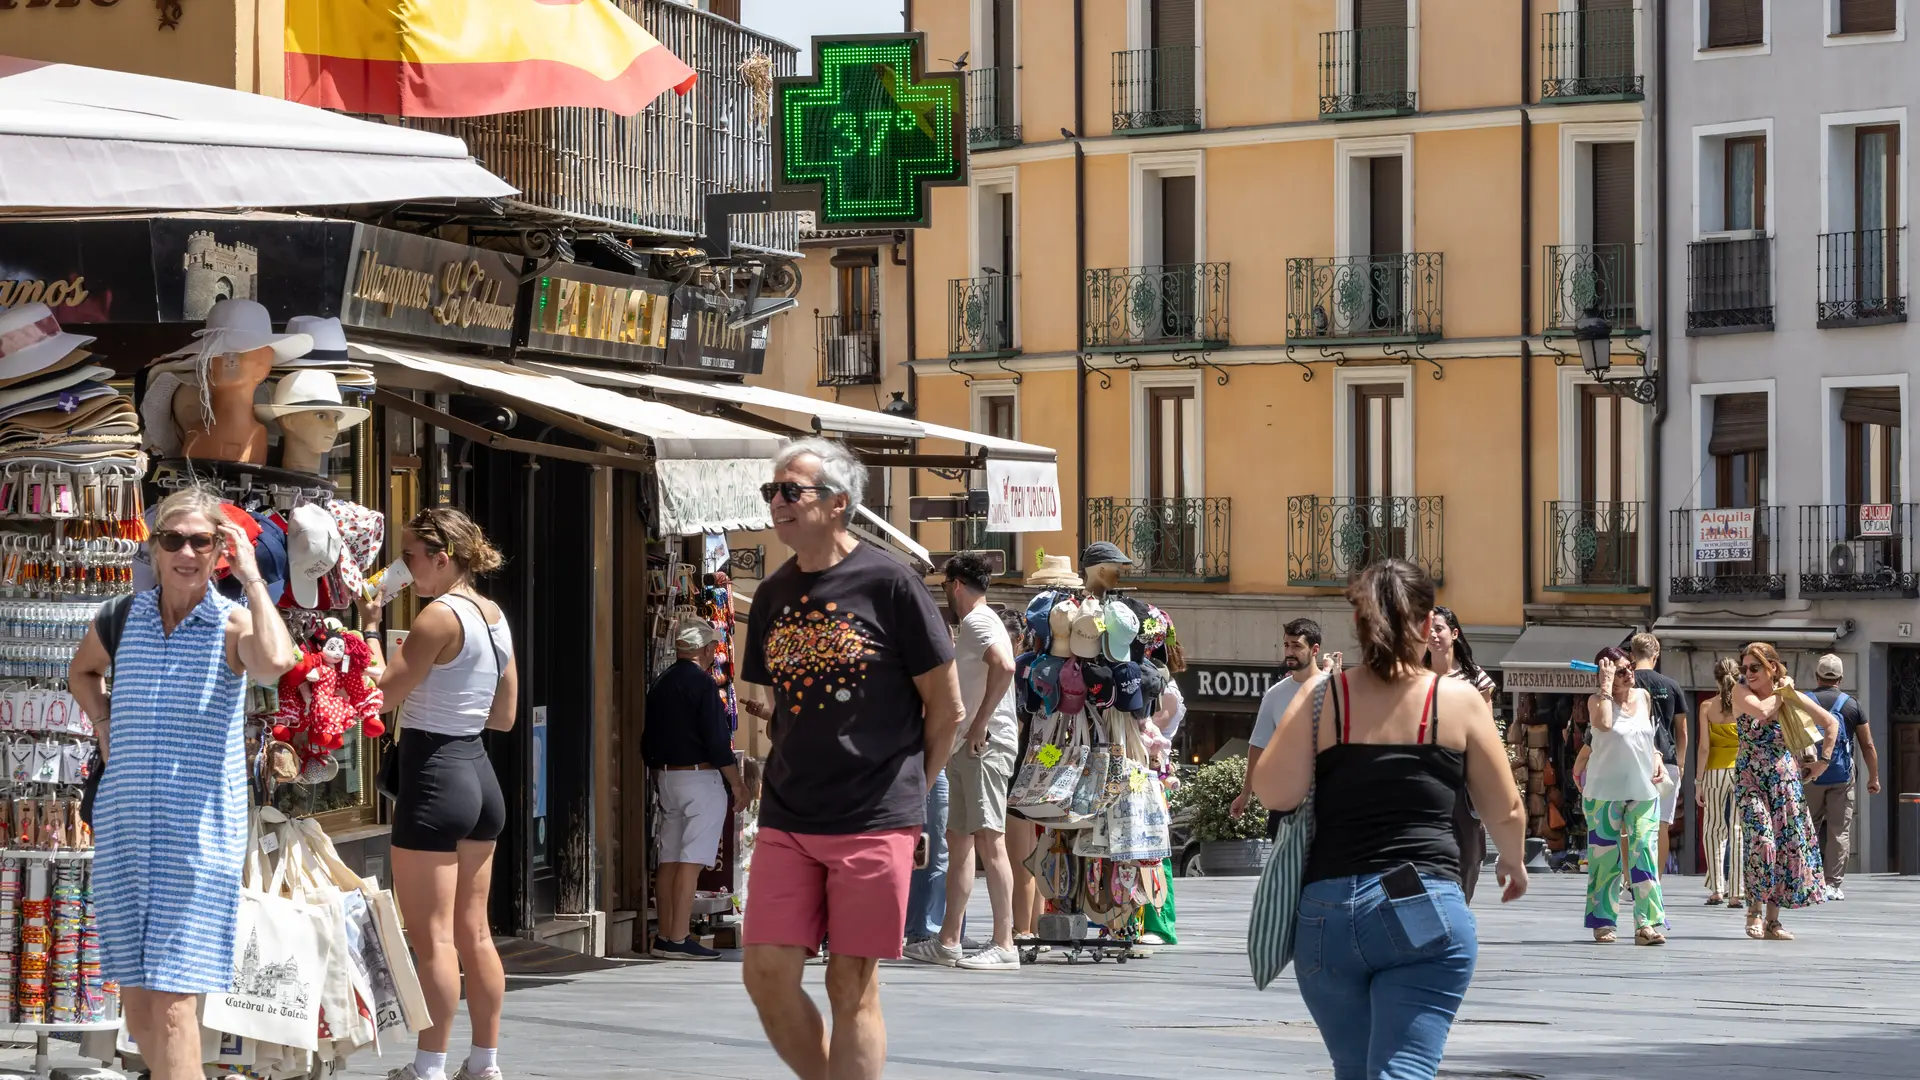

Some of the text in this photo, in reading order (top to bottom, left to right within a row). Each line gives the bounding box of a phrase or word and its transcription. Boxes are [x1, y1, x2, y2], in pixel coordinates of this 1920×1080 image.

[834, 111, 916, 157] 37°
[354, 250, 516, 330] Mazapanes Los Toledanos
[1011, 486, 1025, 518] TREN
[1700, 511, 1752, 524] Alquila
[1698, 550, 1716, 559] 925
[1718, 549, 1729, 558] 28
[1731, 549, 1740, 558] 56
[1506, 670, 1554, 687] ARTESANÍA
[225, 996, 309, 1021] Catedral de Toledo
